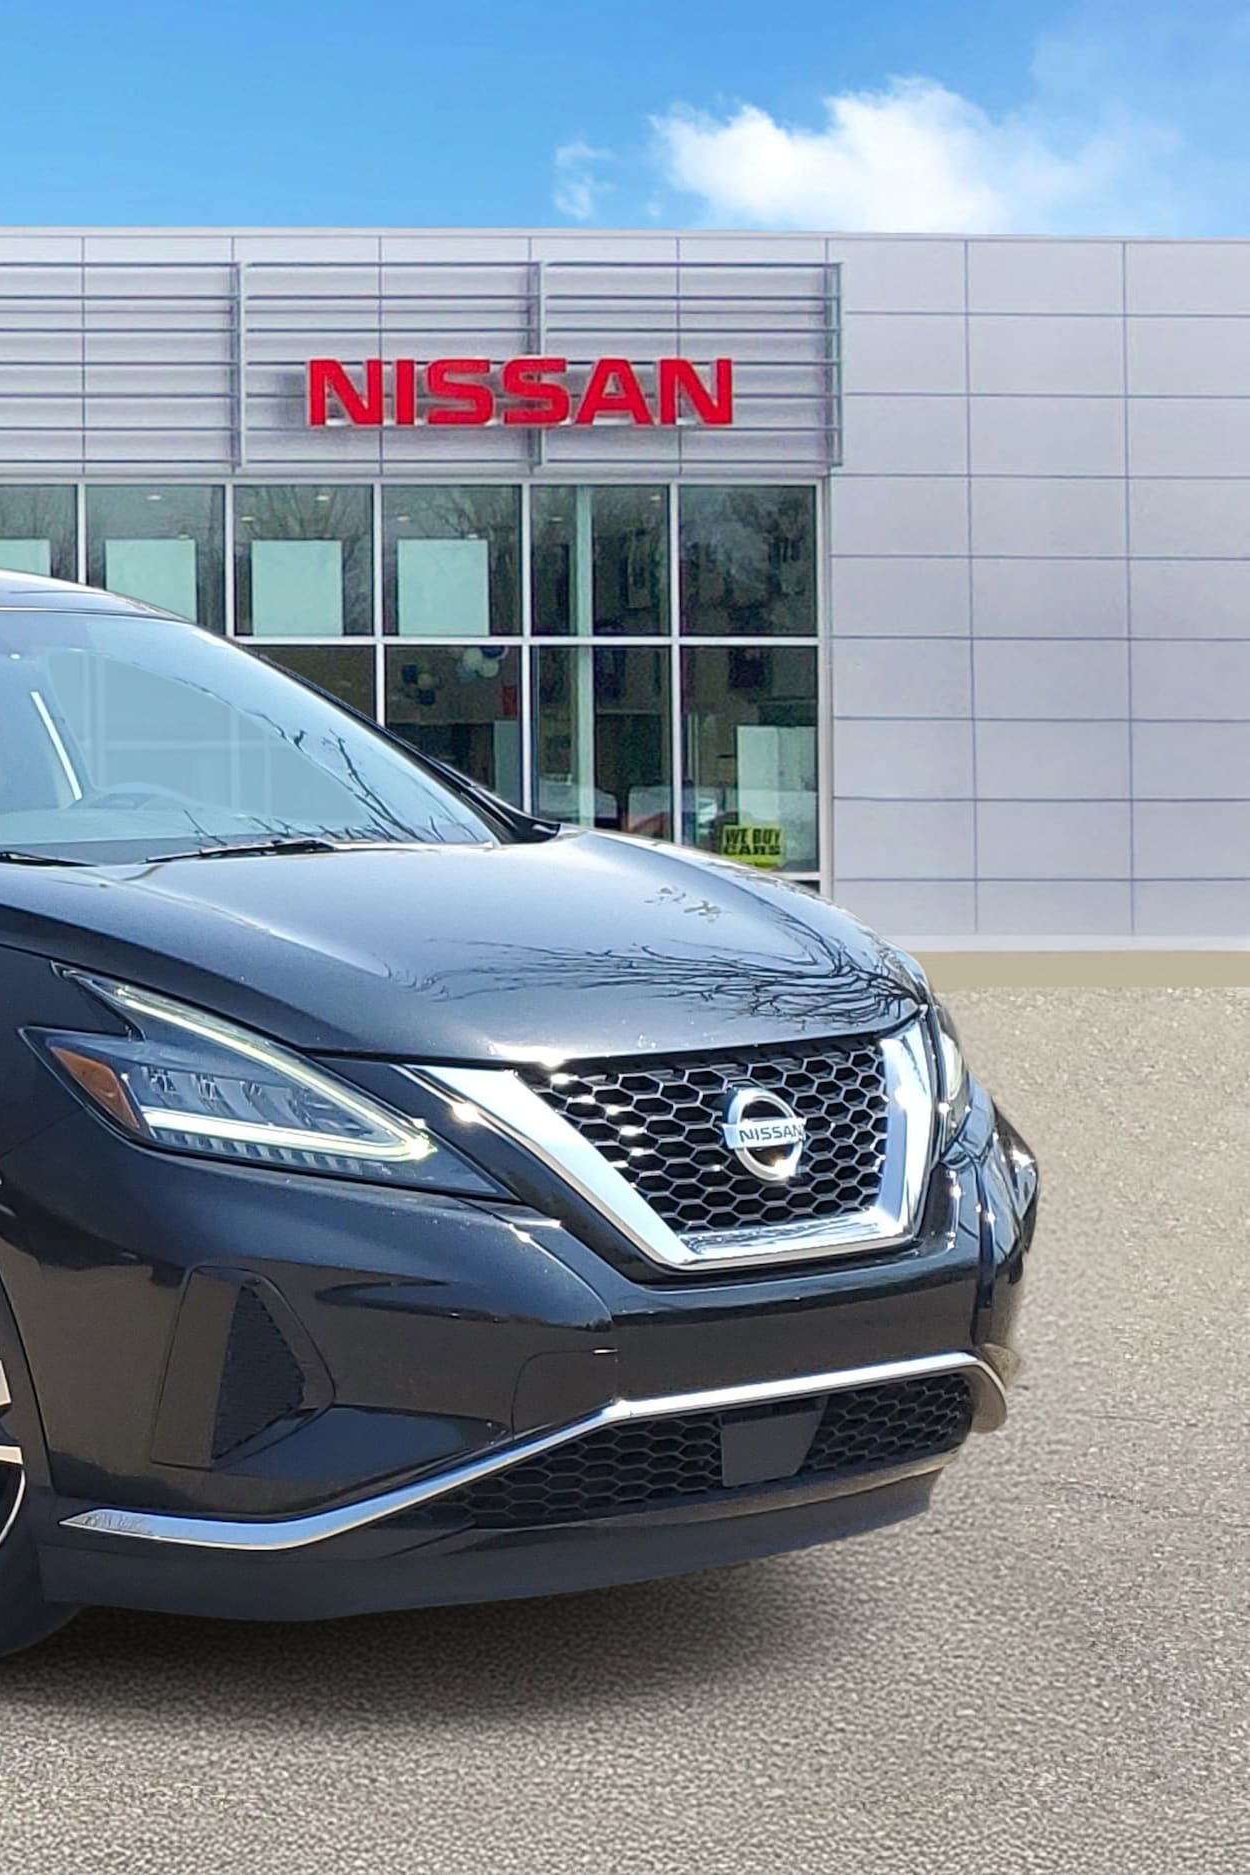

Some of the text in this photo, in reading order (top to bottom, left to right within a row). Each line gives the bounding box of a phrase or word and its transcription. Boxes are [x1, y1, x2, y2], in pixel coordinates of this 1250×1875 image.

[307, 357, 734, 427] NISSAN
[724, 828, 782, 845] WE BUY
[723, 844, 781, 856] CARS
[738, 1124, 804, 1143] NISSAN
